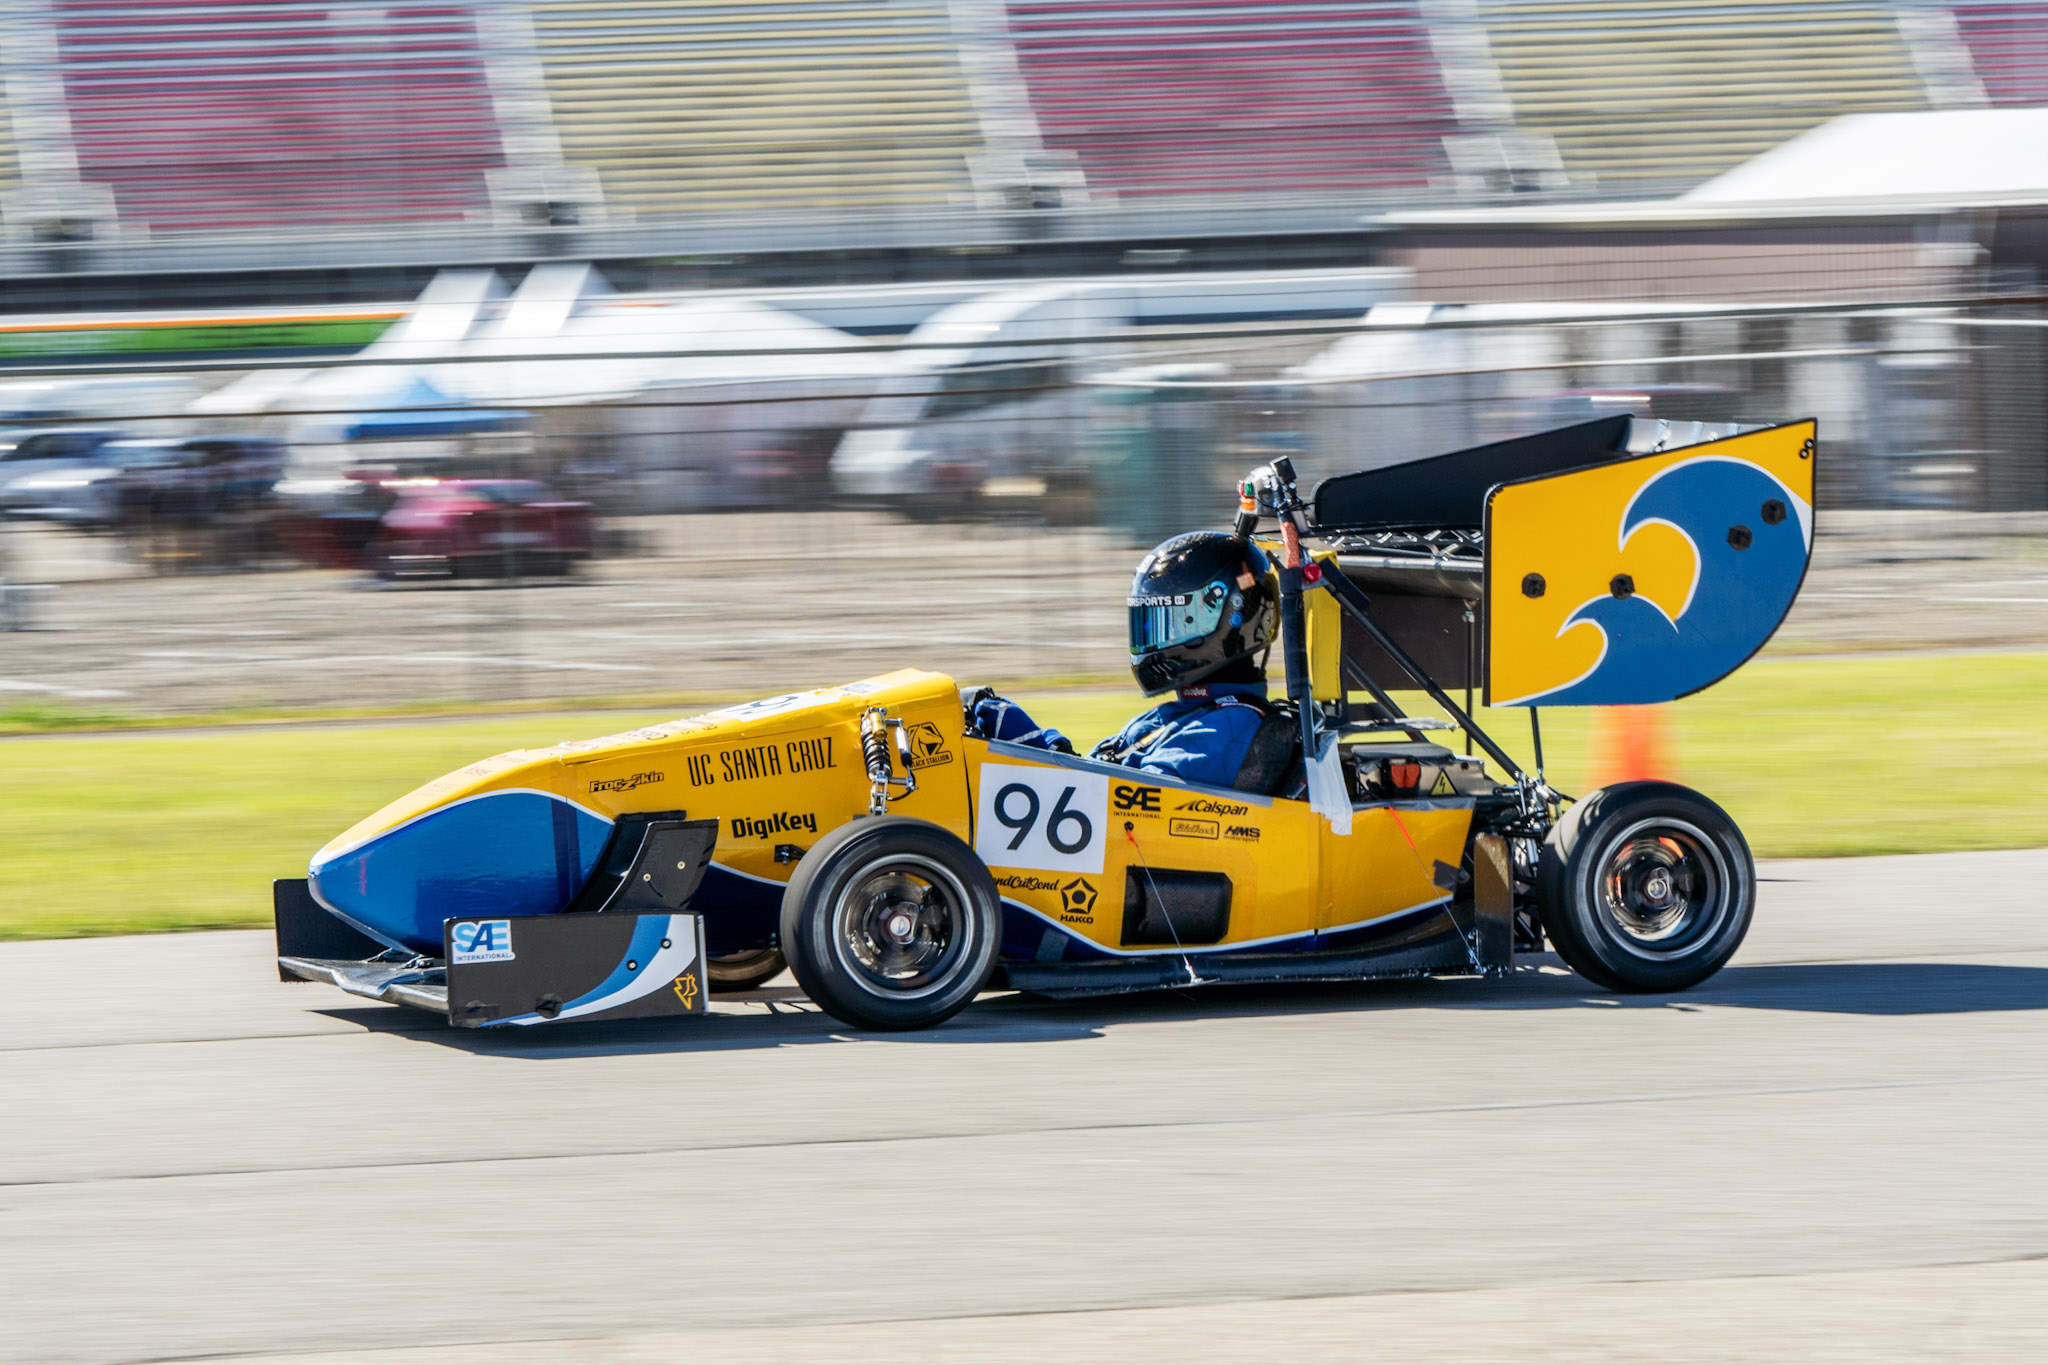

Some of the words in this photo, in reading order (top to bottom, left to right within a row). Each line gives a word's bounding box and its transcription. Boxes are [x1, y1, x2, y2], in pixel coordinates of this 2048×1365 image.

[687, 754, 715, 787] UC
[720, 745, 782, 782] SANTA
[787, 737, 838, 773] CRUZ
[1113, 785, 1162, 812] SAE
[1194, 799, 1249, 817] Calspan
[731, 811, 818, 840] DigiKey
[994, 783, 1092, 854] 96
[1224, 825, 1261, 838] HMS
[455, 921, 509, 953] SAE
[456, 953, 510, 961] INTERNATIONAL
